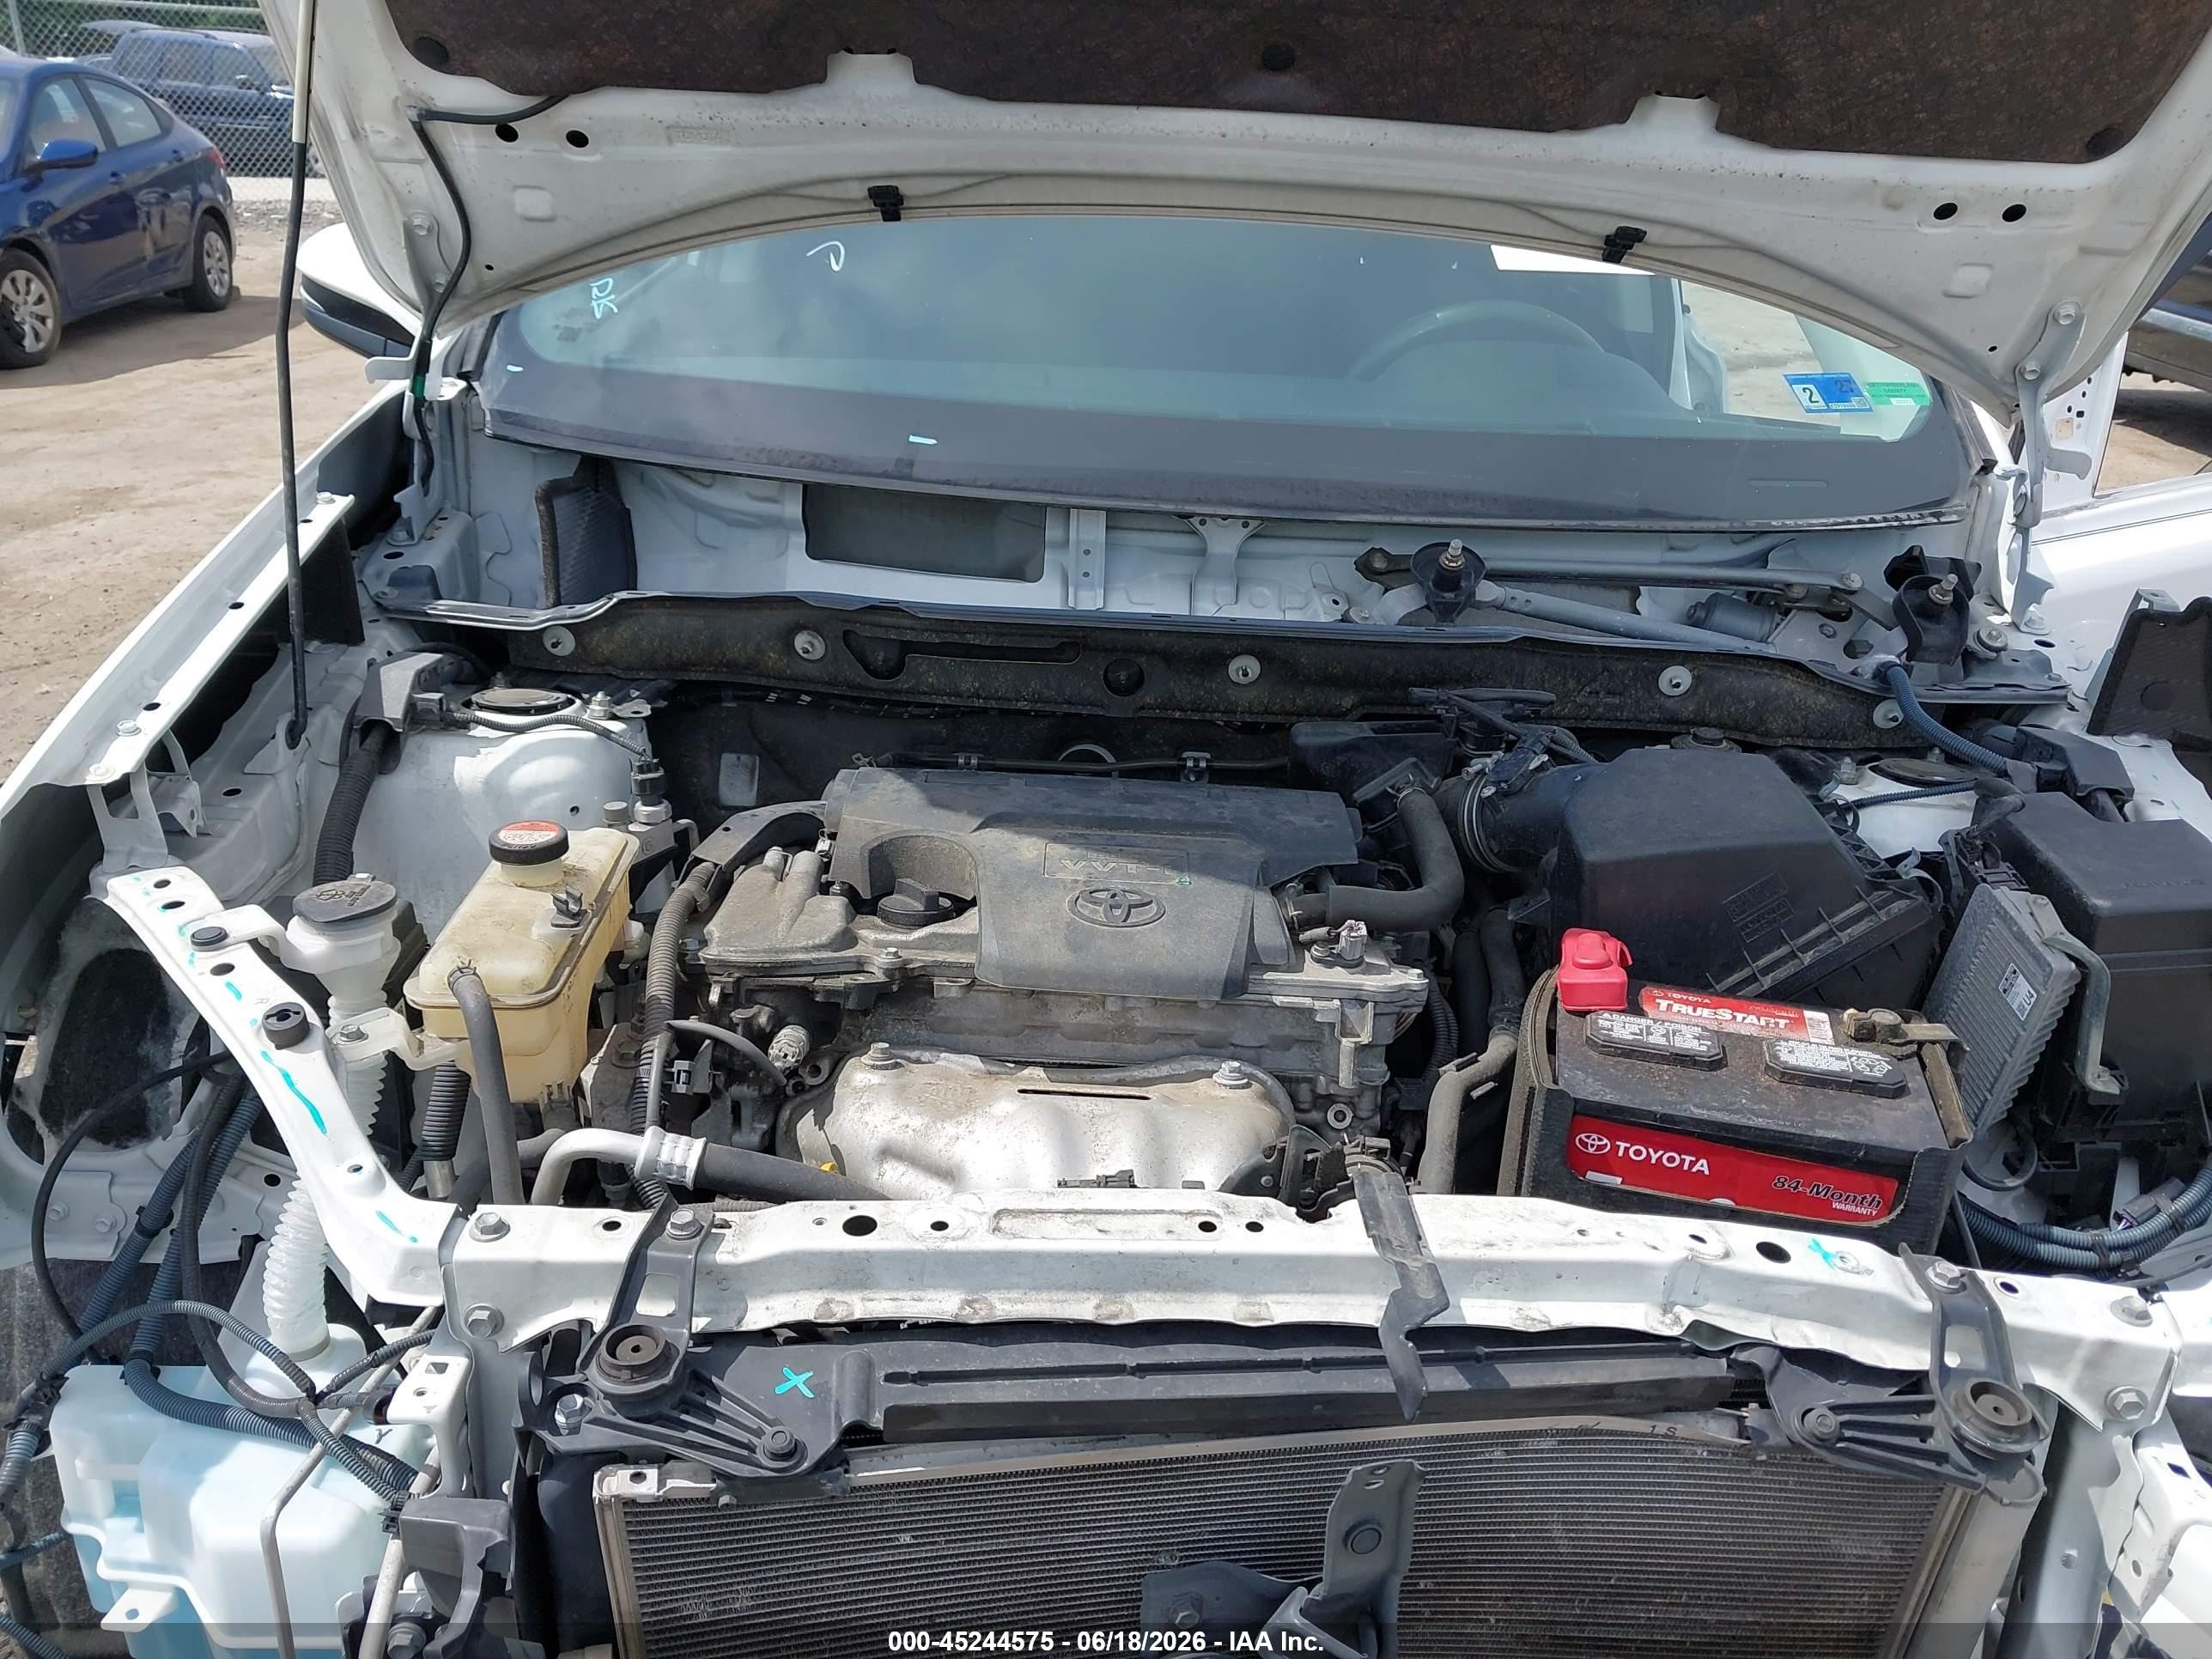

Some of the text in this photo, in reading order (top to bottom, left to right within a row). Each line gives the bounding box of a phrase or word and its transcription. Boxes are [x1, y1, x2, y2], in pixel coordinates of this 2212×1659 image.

[1802, 386, 1820, 404] 2
[1667, 992, 1711, 1004] TOYOTA
[2022, 989, 2034, 1006] U4
[1611, 1013, 1655, 1025] DANGER
[1615, 1141, 1710, 1176] TOYOTA
[1771, 1175, 1883, 1209] 84-Month
[1831, 1201, 1878, 1217] WARRANTY
